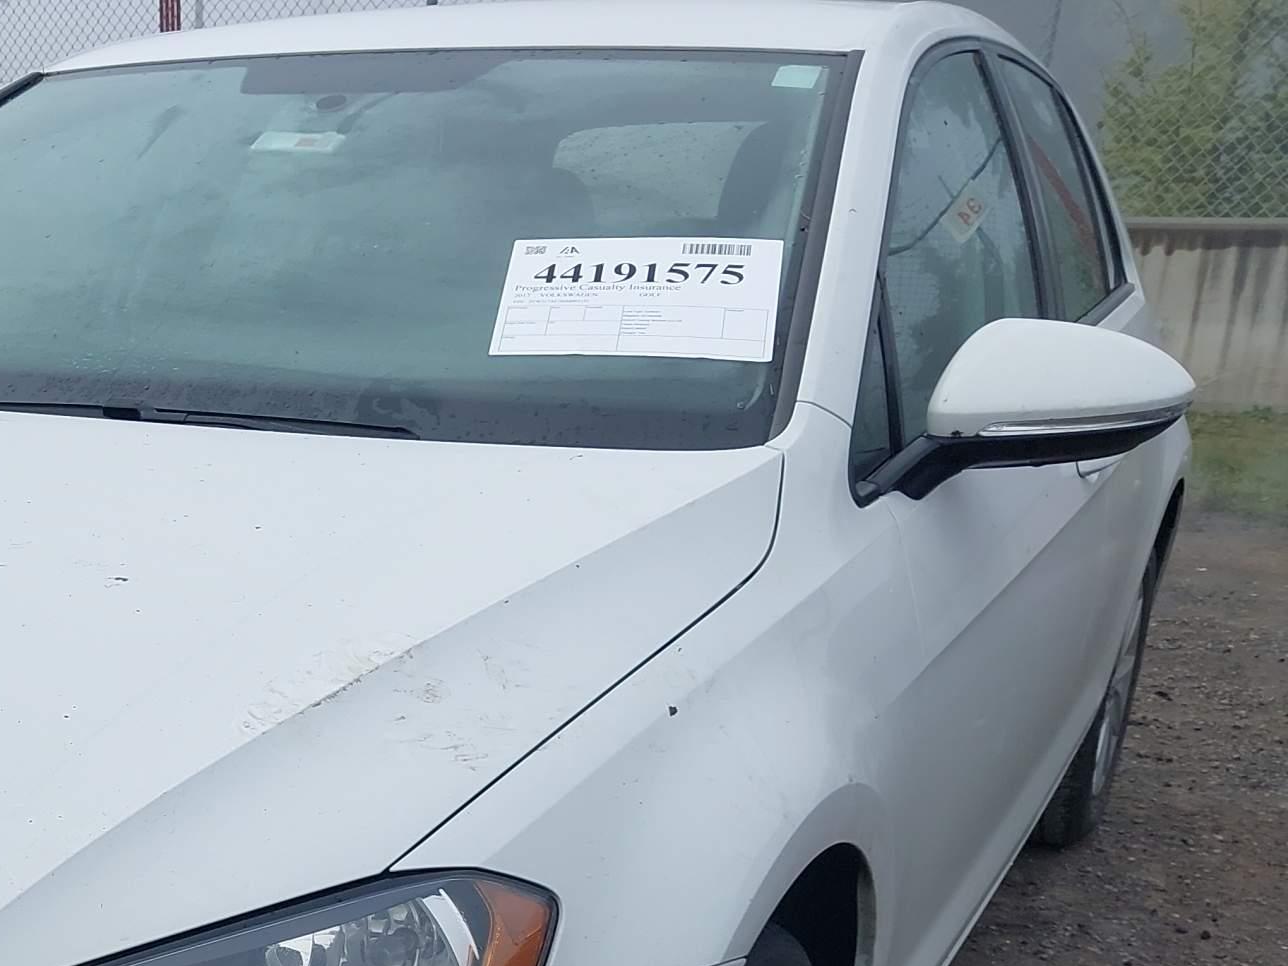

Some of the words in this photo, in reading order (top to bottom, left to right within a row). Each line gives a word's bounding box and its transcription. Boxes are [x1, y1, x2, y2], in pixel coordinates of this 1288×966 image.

[533, 262, 746, 285] 44191575
[515, 284, 576, 293] Progressive
[579, 284, 626, 292] Casualty
[629, 284, 682, 292] Insurance
